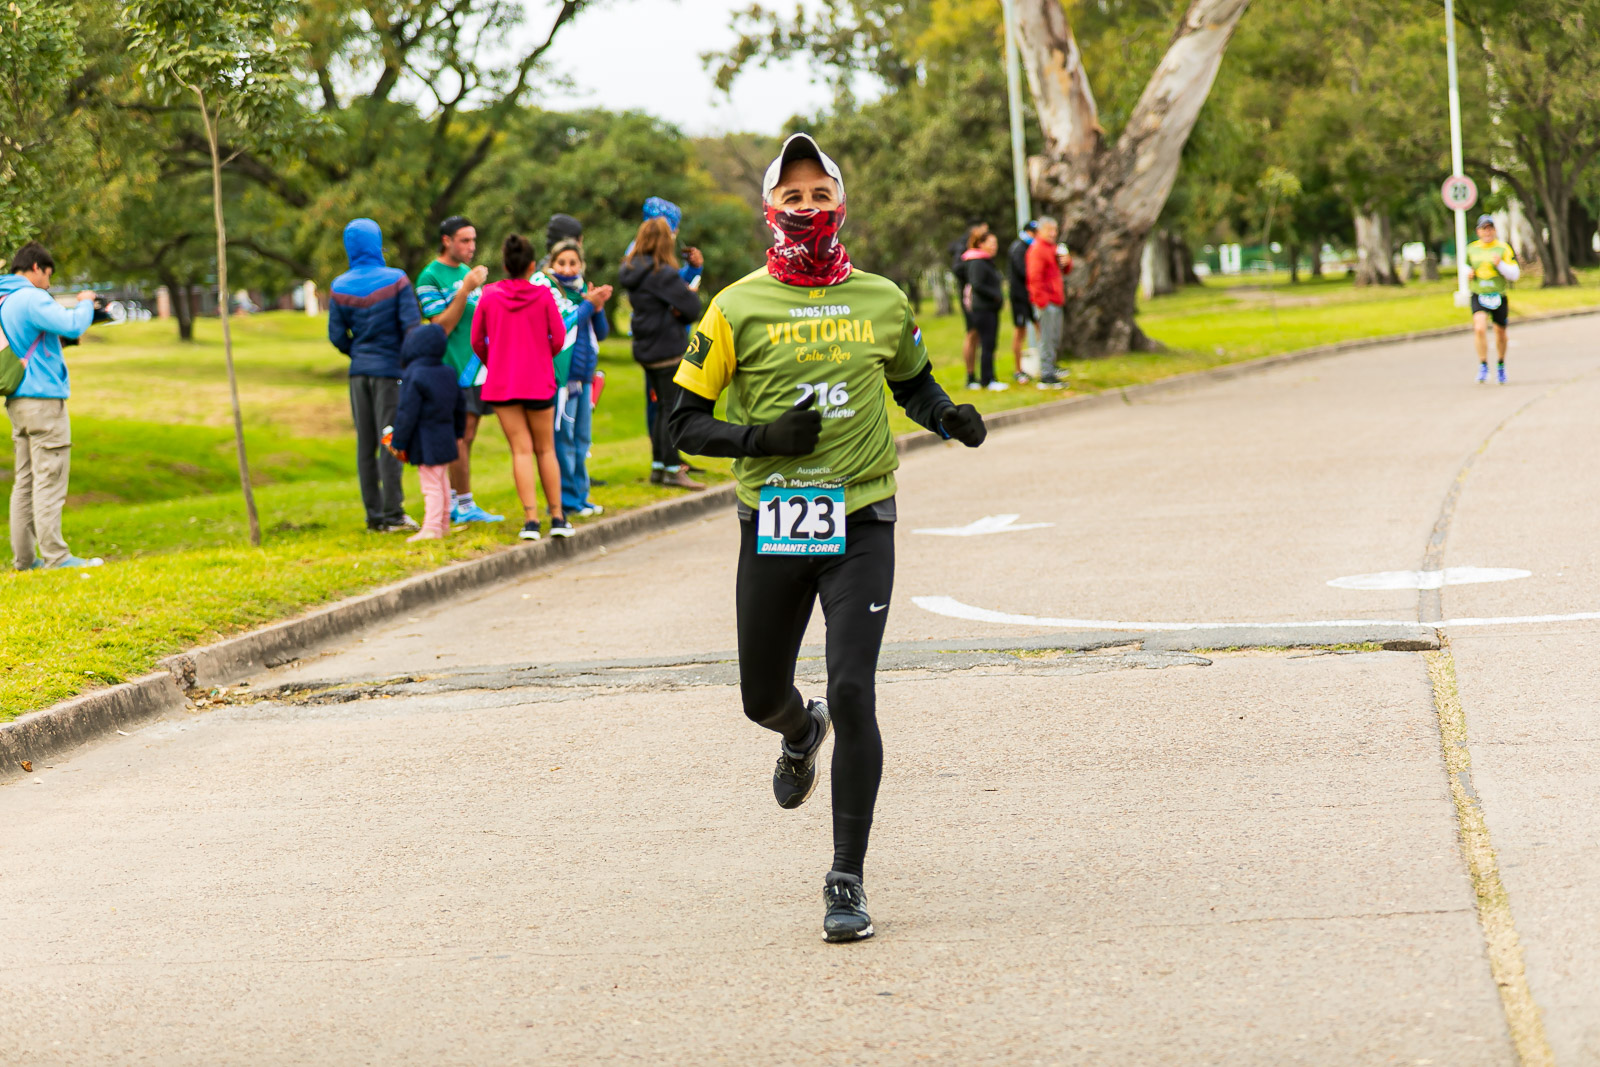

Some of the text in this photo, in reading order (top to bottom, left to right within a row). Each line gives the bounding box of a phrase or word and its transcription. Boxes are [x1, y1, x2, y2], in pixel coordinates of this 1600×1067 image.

[789, 305, 850, 317] 13/05/1810
[767, 318, 875, 345] VICTORIA
[795, 346, 824, 363] Entre
[793, 381, 849, 406] 216
[767, 495, 836, 542] 123
[762, 543, 841, 553] DIAMANTE CORRE
